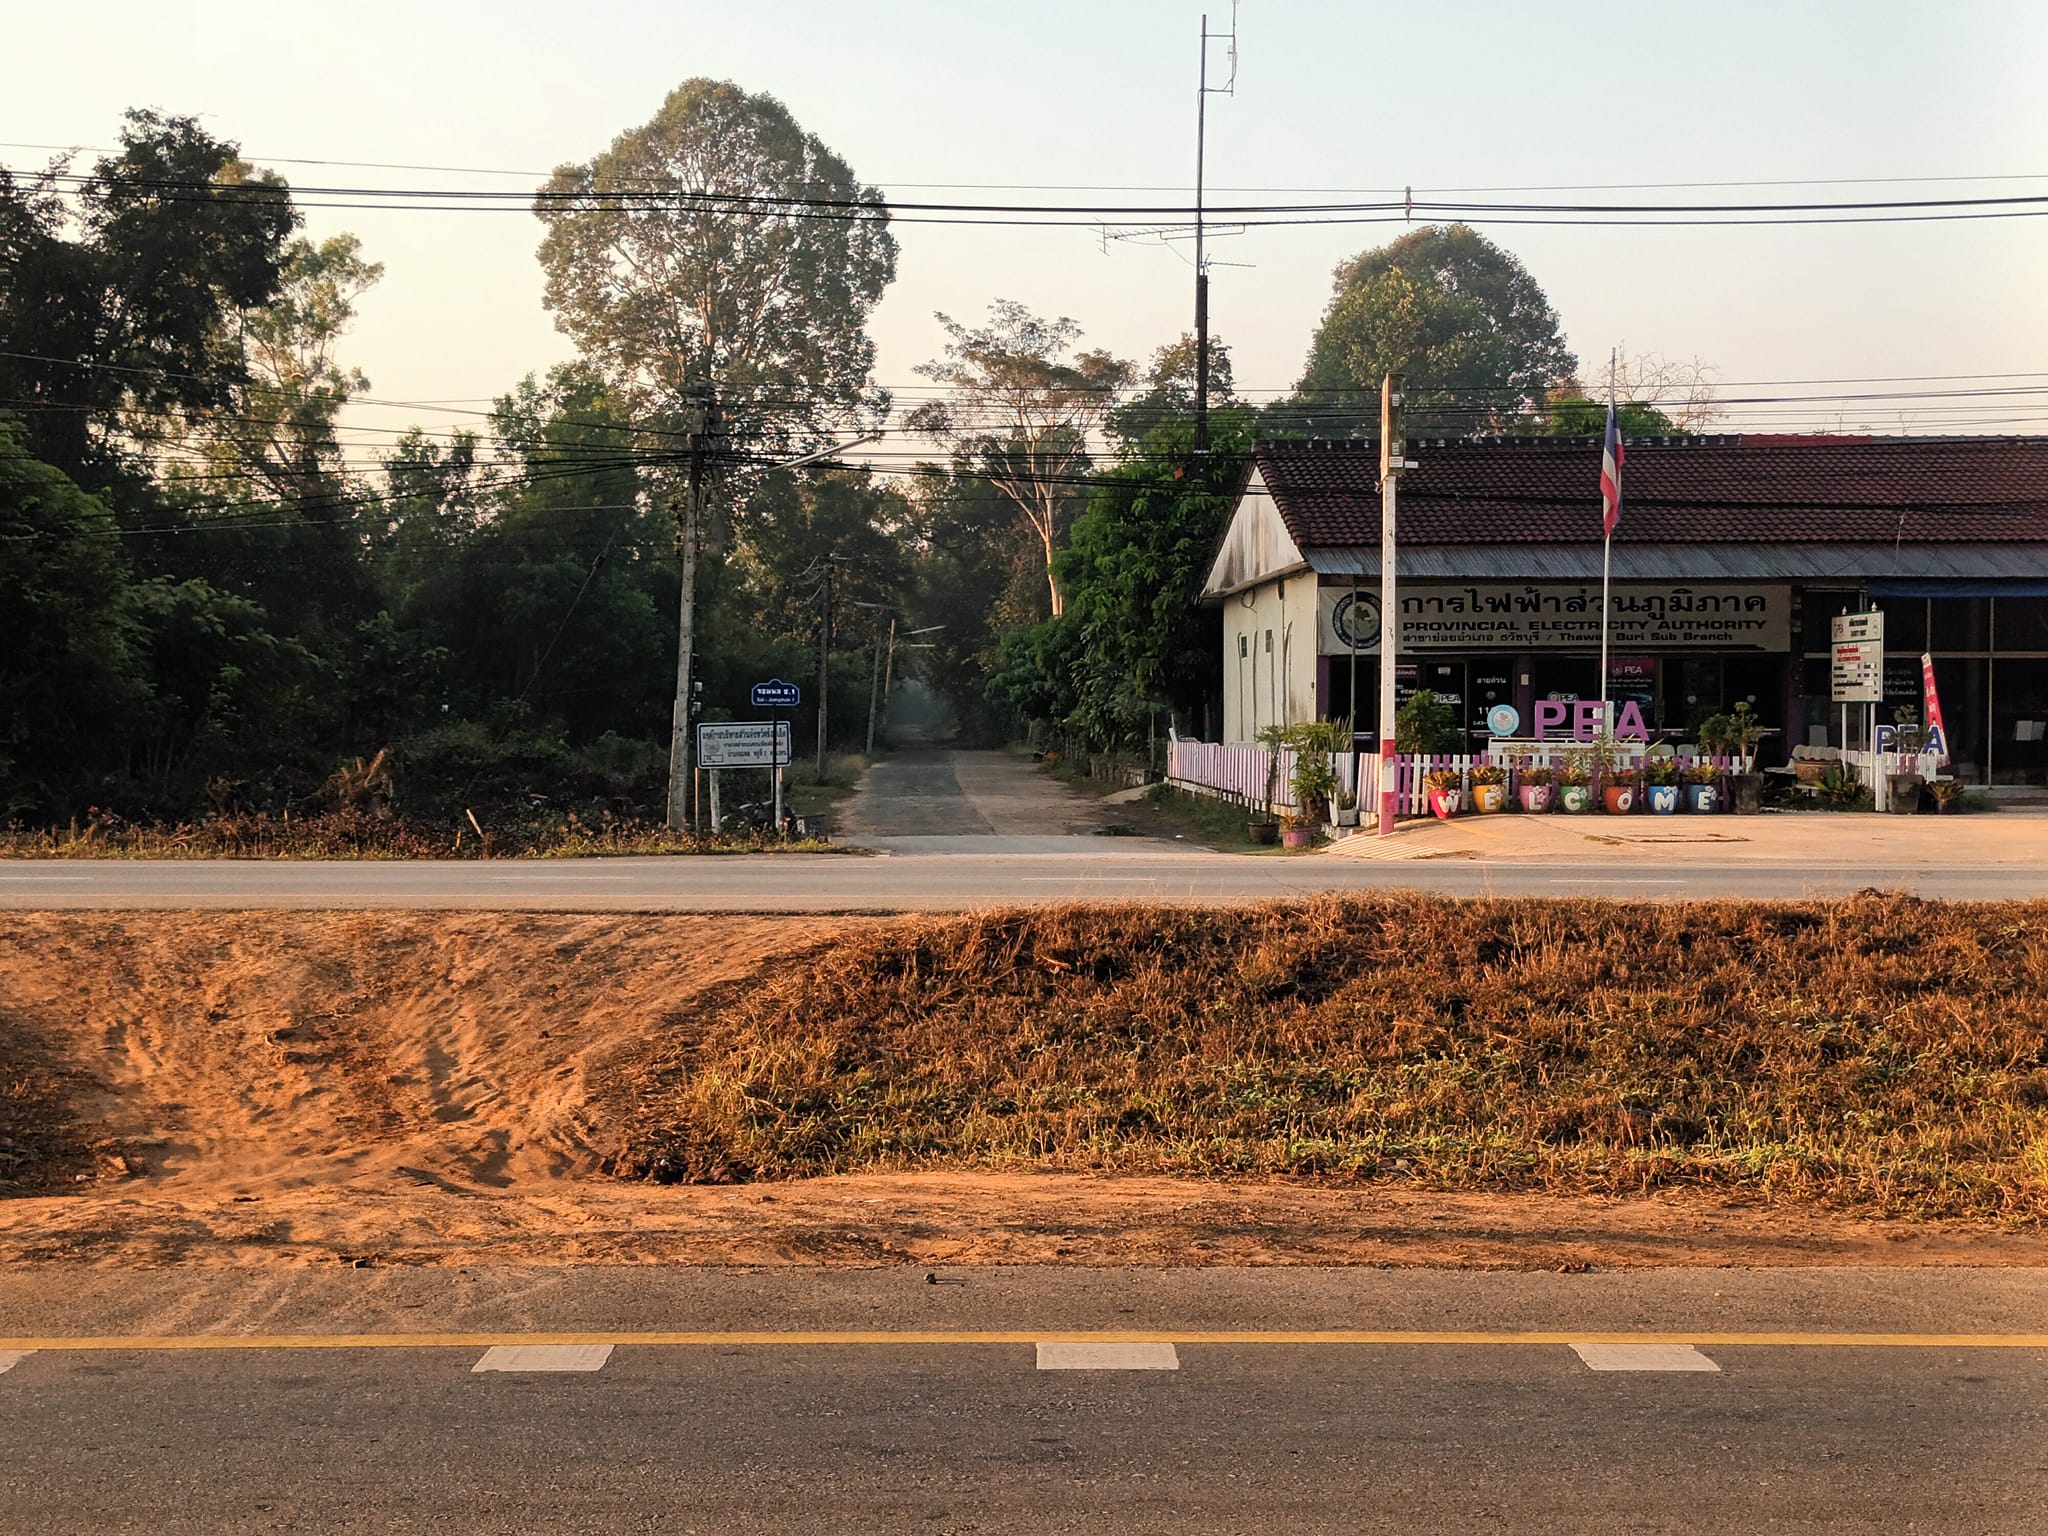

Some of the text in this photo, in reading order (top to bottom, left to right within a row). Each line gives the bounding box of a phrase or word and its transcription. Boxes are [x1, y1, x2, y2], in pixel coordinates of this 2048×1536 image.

[1402, 587, 1766, 620] การไฟฟ้าส่วนภูมิภาค
[1403, 621, 1519, 631] PROVINCIAL
[1658, 620, 1766, 630] AUTHORITY
[1616, 632, 1644, 641] Buri
[1651, 632, 1677, 641] Sub
[1683, 632, 1733, 641] Branch
[1440, 693, 1461, 703] PEA
[1534, 700, 1650, 742] PEA
